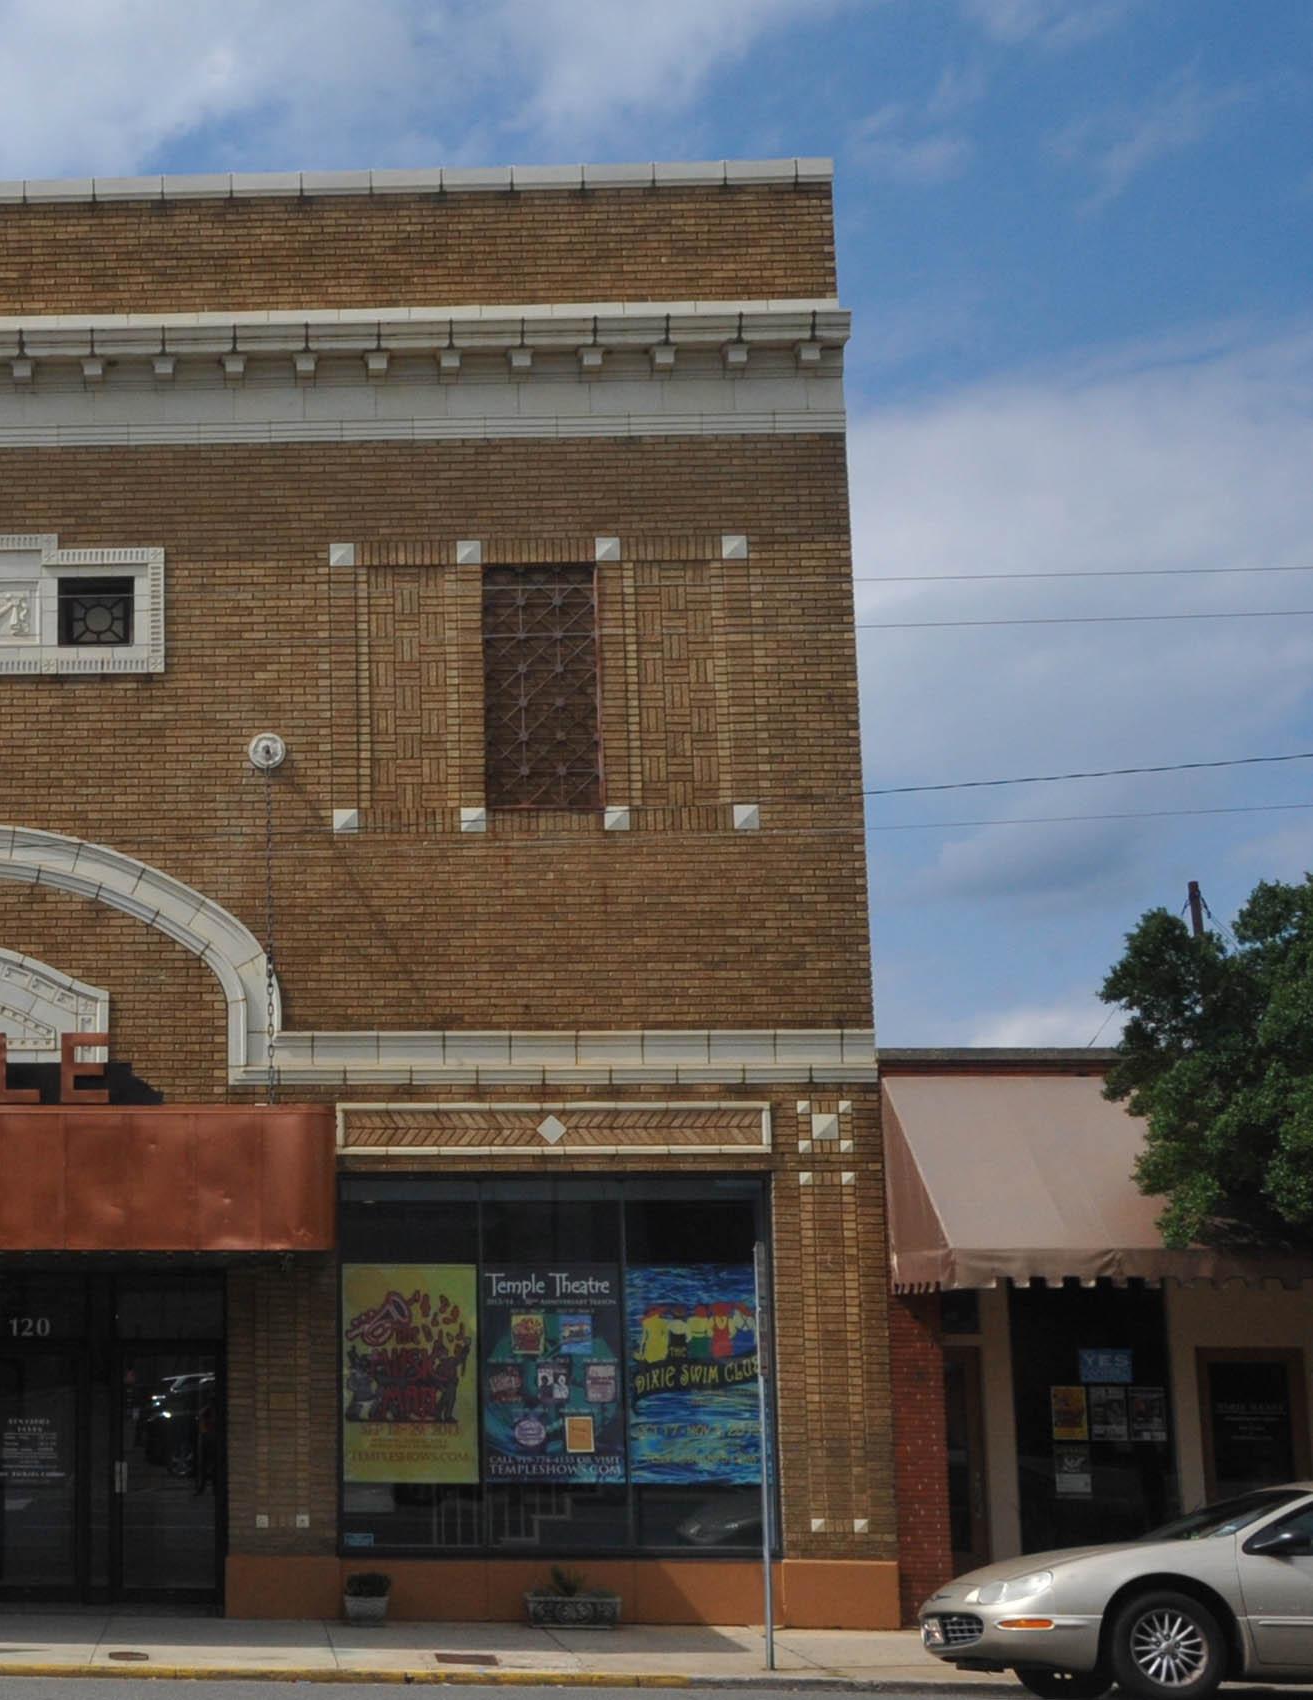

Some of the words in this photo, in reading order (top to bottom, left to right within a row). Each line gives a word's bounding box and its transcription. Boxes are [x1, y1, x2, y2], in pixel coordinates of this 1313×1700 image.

[484, 1272, 546, 1299] Temple
[548, 1272, 610, 1297] Theatre
[9, 1317, 51, 1336] 120
[1082, 1353, 1129, 1367] YES
[634, 1366, 677, 1394] DIXIE
[679, 1364, 719, 1386] SWIM
[723, 1355, 761, 1382] CLUB
[351, 1451, 470, 1462] TEMPLESHOWS.COM
[488, 1455, 512, 1464] CALL
[594, 1455, 621, 1464] VISIT
[489, 1463, 622, 1475] TEMPLESHOWS.COM
